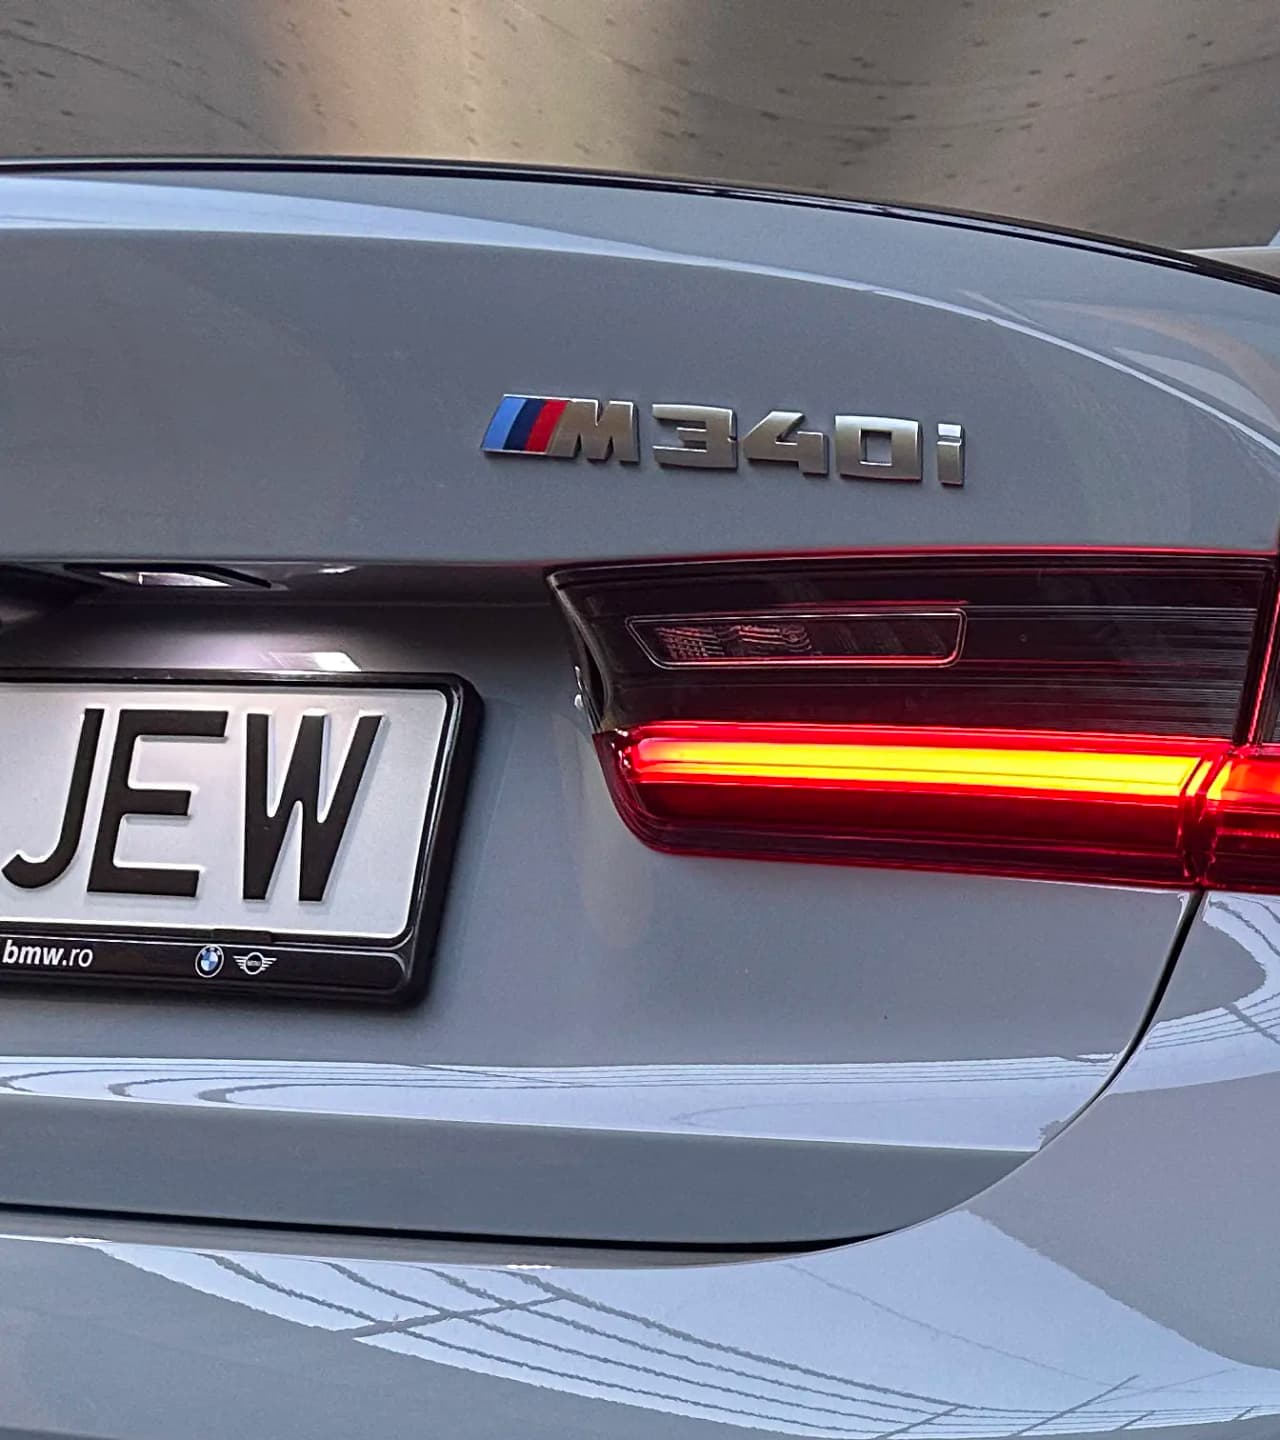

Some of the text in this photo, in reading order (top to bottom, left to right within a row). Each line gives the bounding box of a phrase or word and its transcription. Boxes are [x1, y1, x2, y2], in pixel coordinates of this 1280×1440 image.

[540, 396, 965, 486] M340i
[2, 708, 384, 902] JEW
[2, 939, 93, 967] bmw.ro
